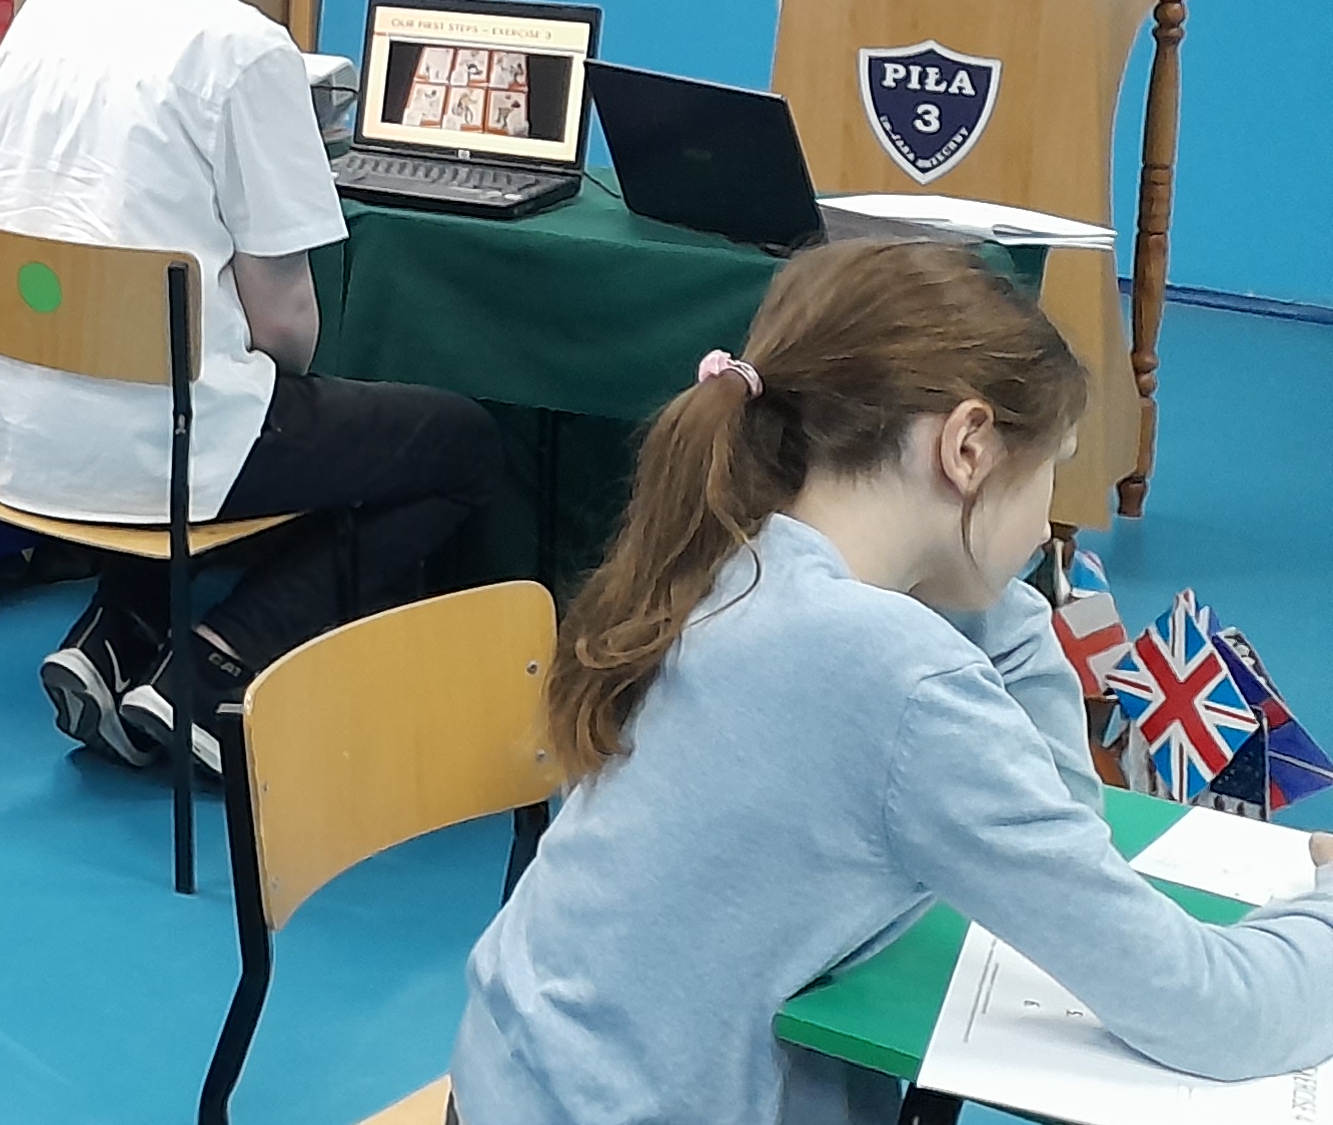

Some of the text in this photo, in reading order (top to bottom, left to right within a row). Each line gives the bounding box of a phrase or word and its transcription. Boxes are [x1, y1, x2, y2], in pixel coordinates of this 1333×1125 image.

[391, 18, 415, 28] OUR
[418, 20, 444, 31] FIRST
[448, 23, 478, 33] STEPS
[881, 63, 976, 96] PIŁA
[913, 104, 940, 133] 3
